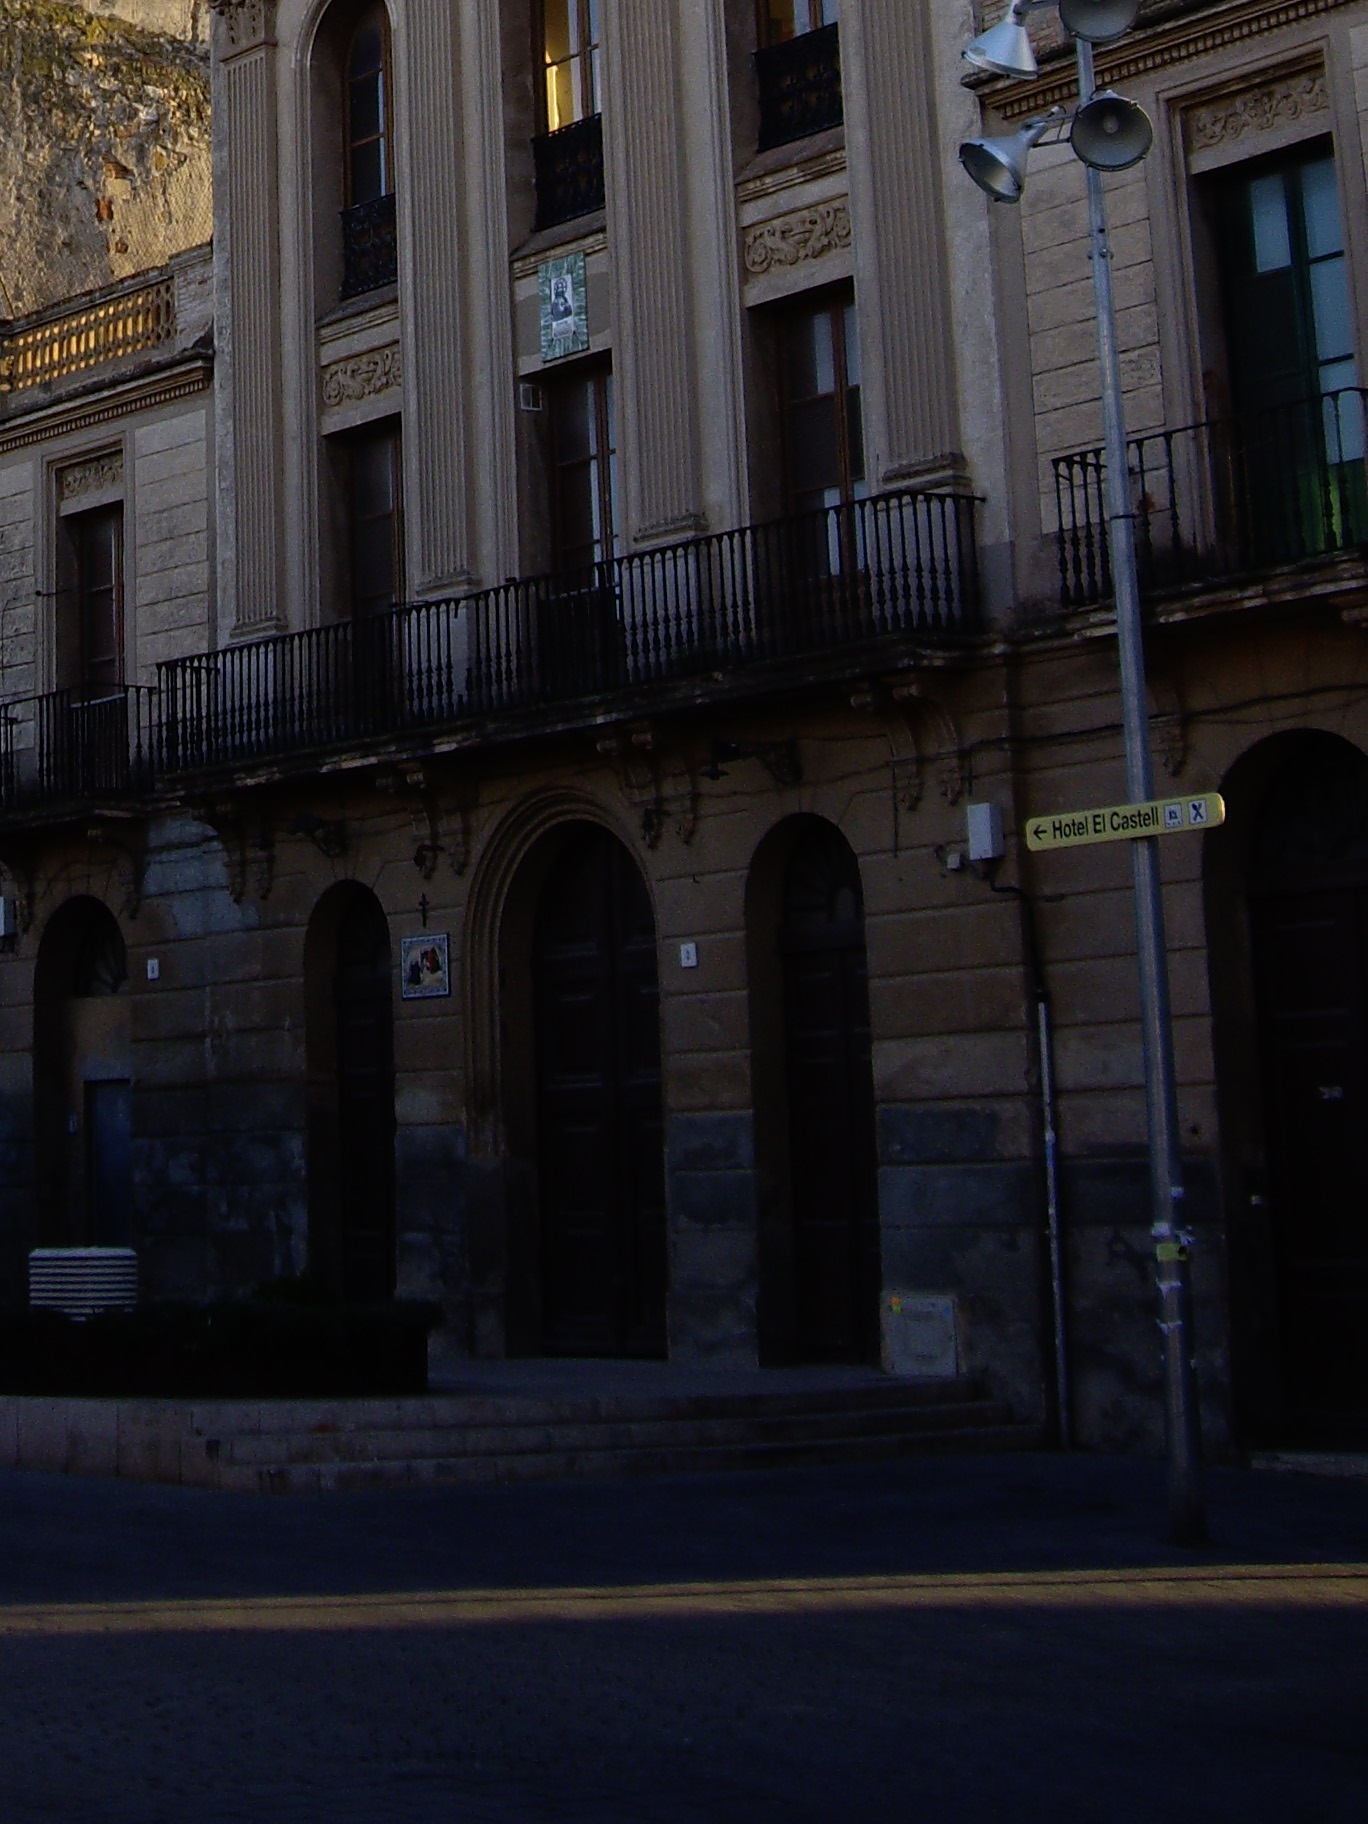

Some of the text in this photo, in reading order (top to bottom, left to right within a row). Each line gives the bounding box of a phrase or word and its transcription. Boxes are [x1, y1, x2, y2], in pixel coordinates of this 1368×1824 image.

[1052, 807, 1159, 839] Hotel El Castell
